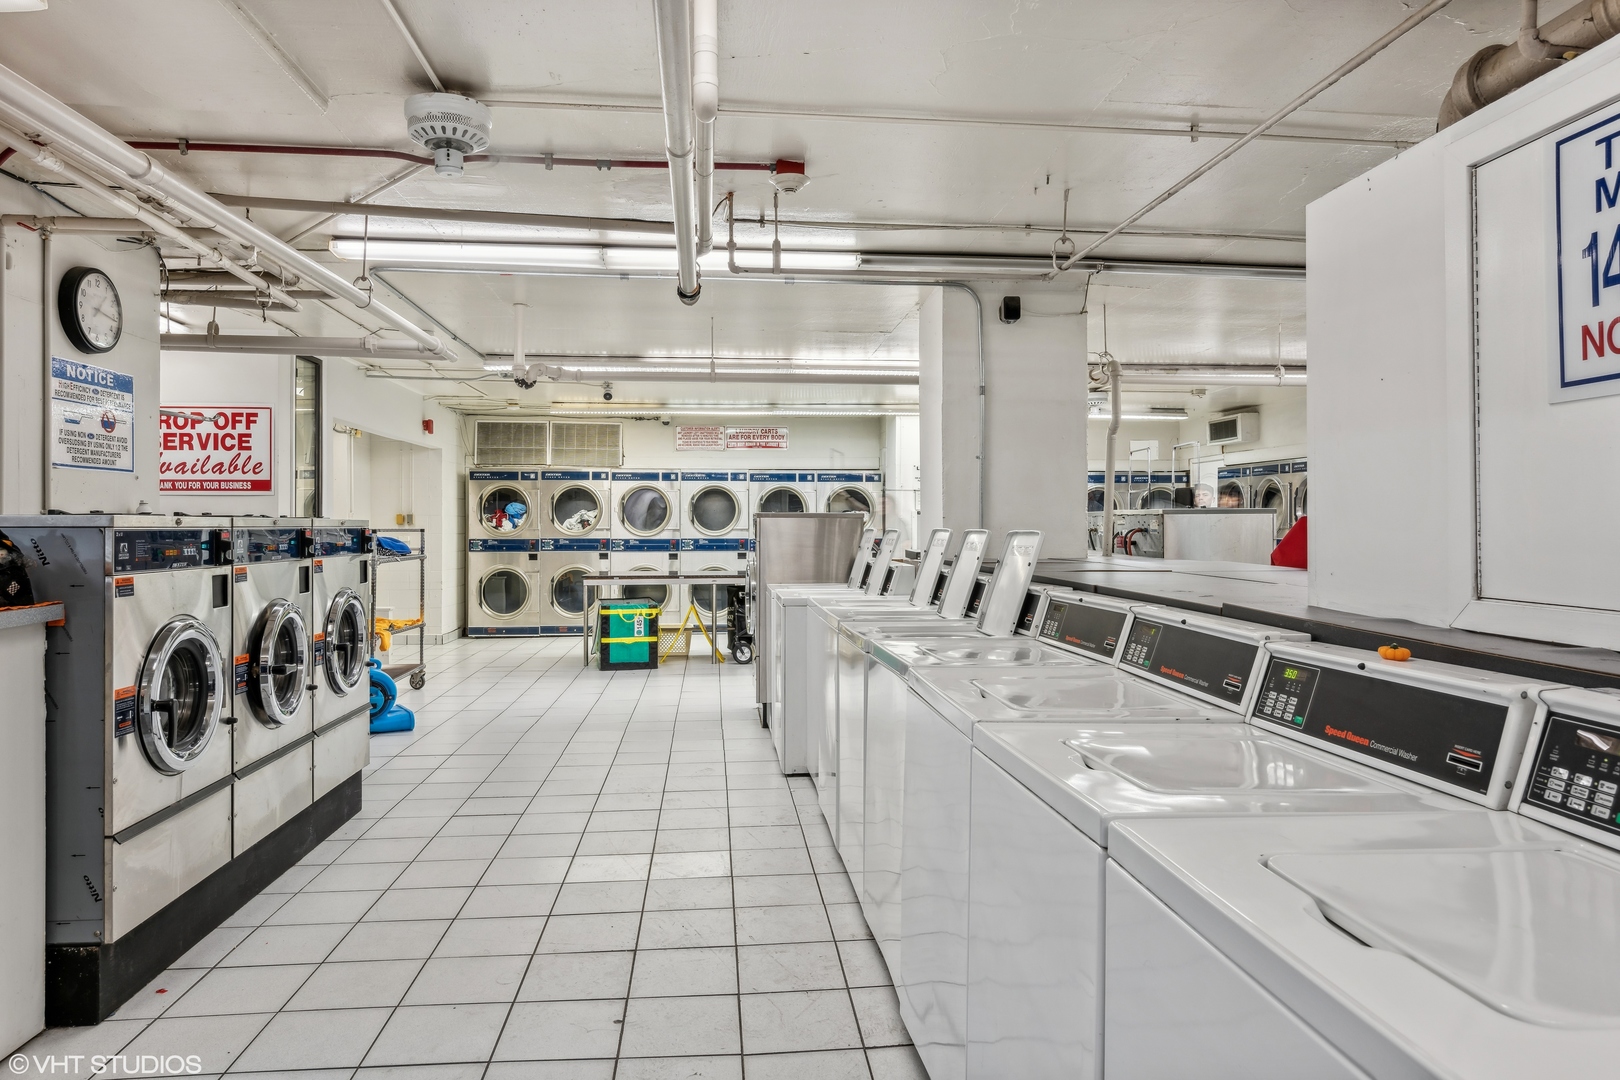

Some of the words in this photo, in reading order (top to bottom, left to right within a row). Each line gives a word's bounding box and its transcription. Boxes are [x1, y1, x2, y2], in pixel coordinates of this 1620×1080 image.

[66, 364, 114, 386] NOTICE
[160, 412, 204, 430] ROP
[213, 412, 258, 430] OFF
[96, 434, 116, 442] DETERGENT
[160, 432, 252, 451] ERVICE
[67, 447, 89, 456] DETERGENT
[72, 456, 101, 465] RECOMMENDED
[160, 452, 264, 475] vailable
[30, 538, 50, 566] Nitto
[1325, 725, 1346, 738] Speed
[1347, 732, 1369, 746] Queen
[1370, 740, 1398, 755] Commercial
[1399, 749, 1418, 761] Washer
[83, 875, 102, 903] Nitto
